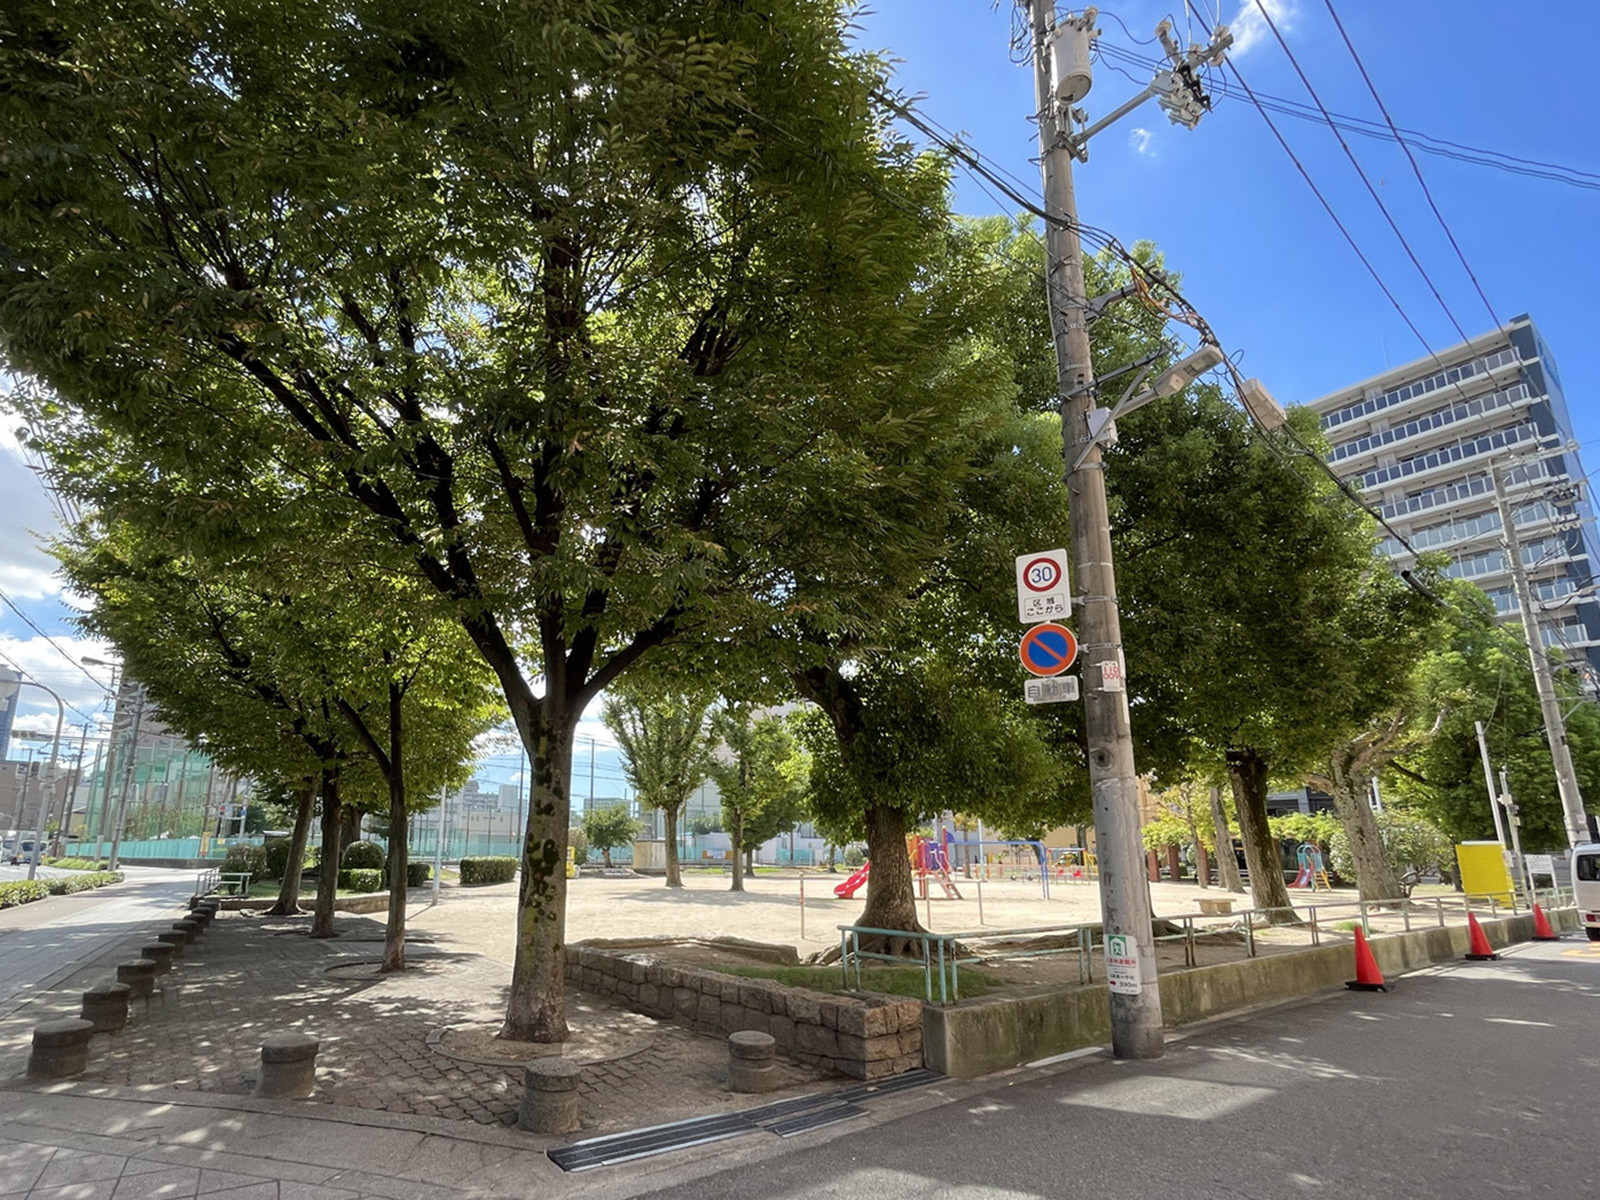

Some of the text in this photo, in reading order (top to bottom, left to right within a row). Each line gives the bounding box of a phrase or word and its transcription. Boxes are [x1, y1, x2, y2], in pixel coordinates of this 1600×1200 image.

[1031, 566, 1052, 584] 30
[1027, 604, 1064, 616] ここから
[1028, 681, 1075, 699] 自動車
